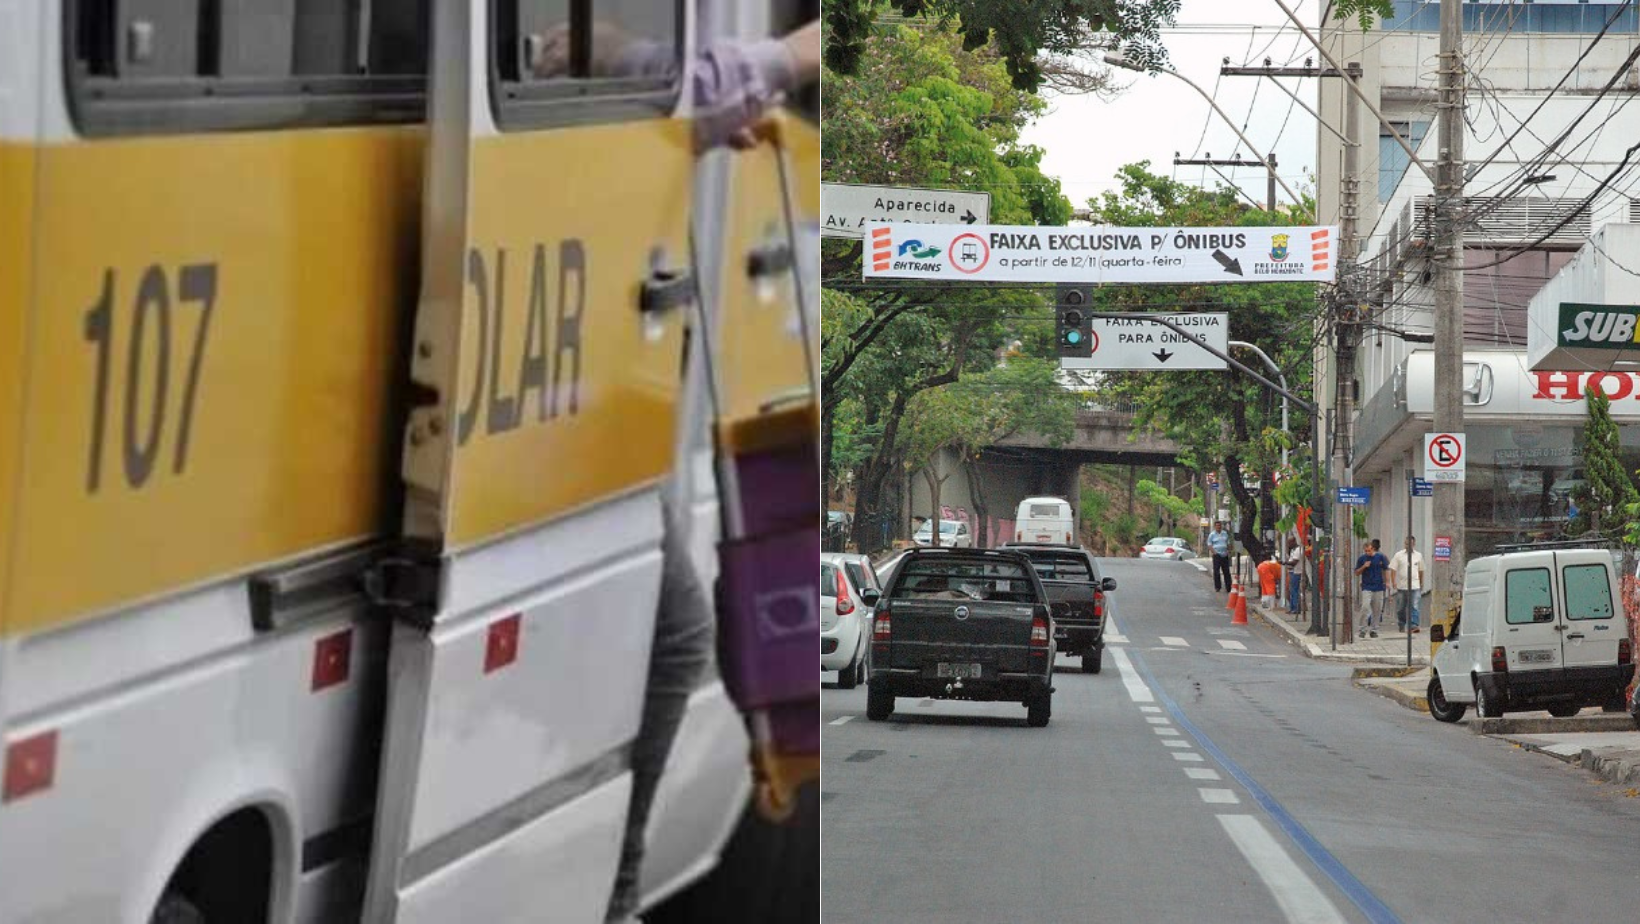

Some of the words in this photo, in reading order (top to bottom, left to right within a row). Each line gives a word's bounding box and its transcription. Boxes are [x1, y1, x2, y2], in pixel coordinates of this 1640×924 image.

[874, 197, 956, 213] Aparecida
[826, 214, 850, 228] Av.
[990, 233, 1041, 250] FAIXA
[1048, 234, 1142, 250] EXCLUSIVA
[1150, 233, 1168, 252] P/
[1173, 230, 1246, 250] ÔNIBUS
[893, 261, 942, 272] BHTRANS
[999, 257, 1008, 266] a
[1011, 256, 1047, 270] partir
[1052, 255, 1068, 267] de
[1071, 254, 1096, 268] 12/11
[1106, 317, 1144, 327] FAIXA
[1562, 311, 1640, 343] SUB
[1119, 333, 1154, 344] PARA
[1160, 331, 1207, 344] ÔNIBS
[83, 262, 218, 495] 107
[1532, 371, 1640, 401] HO
